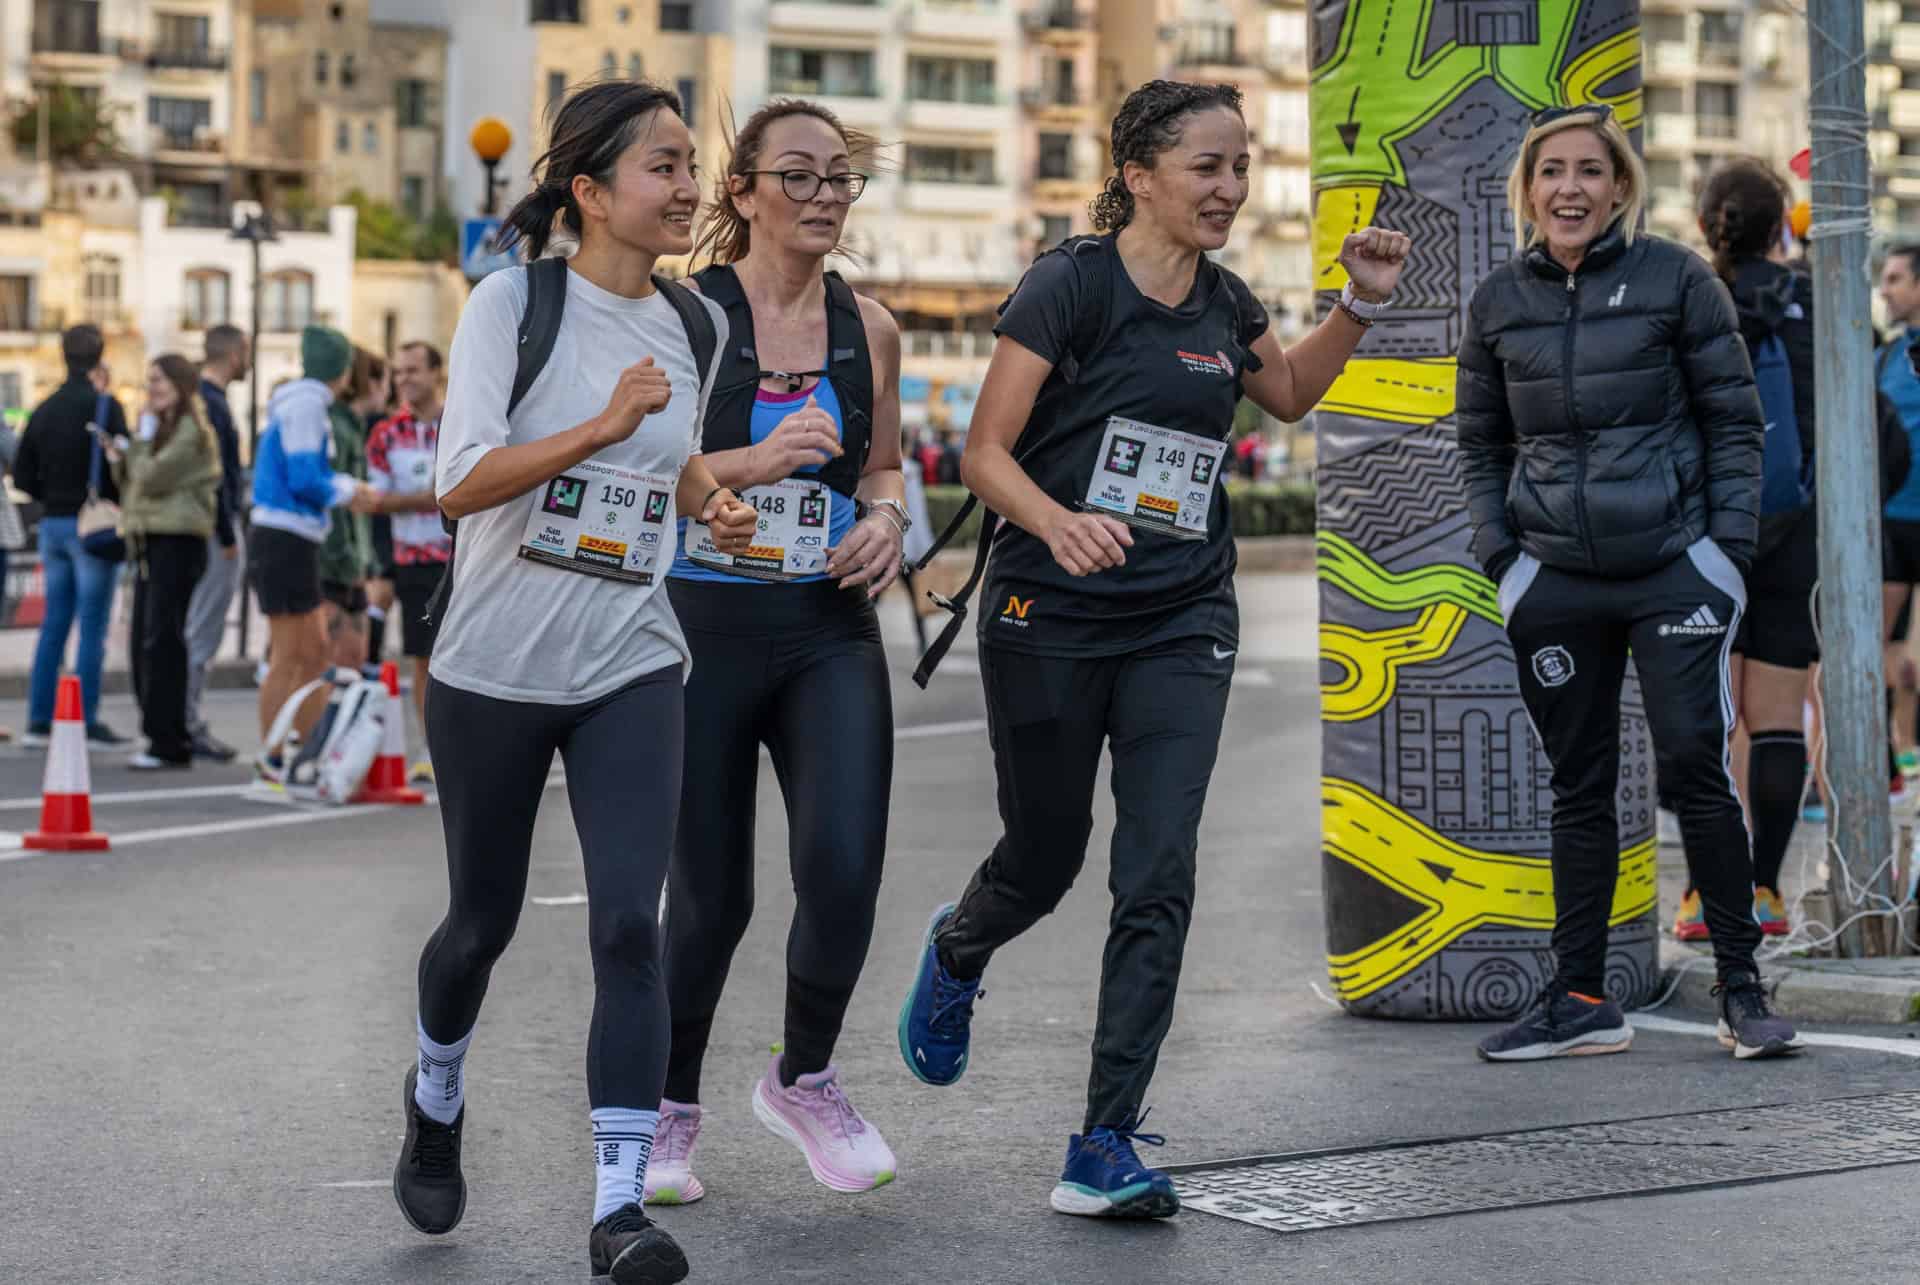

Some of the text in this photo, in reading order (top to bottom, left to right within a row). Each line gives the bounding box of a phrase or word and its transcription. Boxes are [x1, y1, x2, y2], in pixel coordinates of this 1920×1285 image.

[1155, 446, 1186, 468] 149
[601, 484, 636, 508] 150
[1101, 490, 1125, 503] Michel
[1107, 484, 1122, 494] San
[750, 495, 785, 514] 148
[1143, 495, 1174, 509] DHL
[537, 531, 564, 546] Michel
[545, 526, 561, 536] San
[586, 538, 621, 553] DHL
[602, 1143, 621, 1166] RUN
